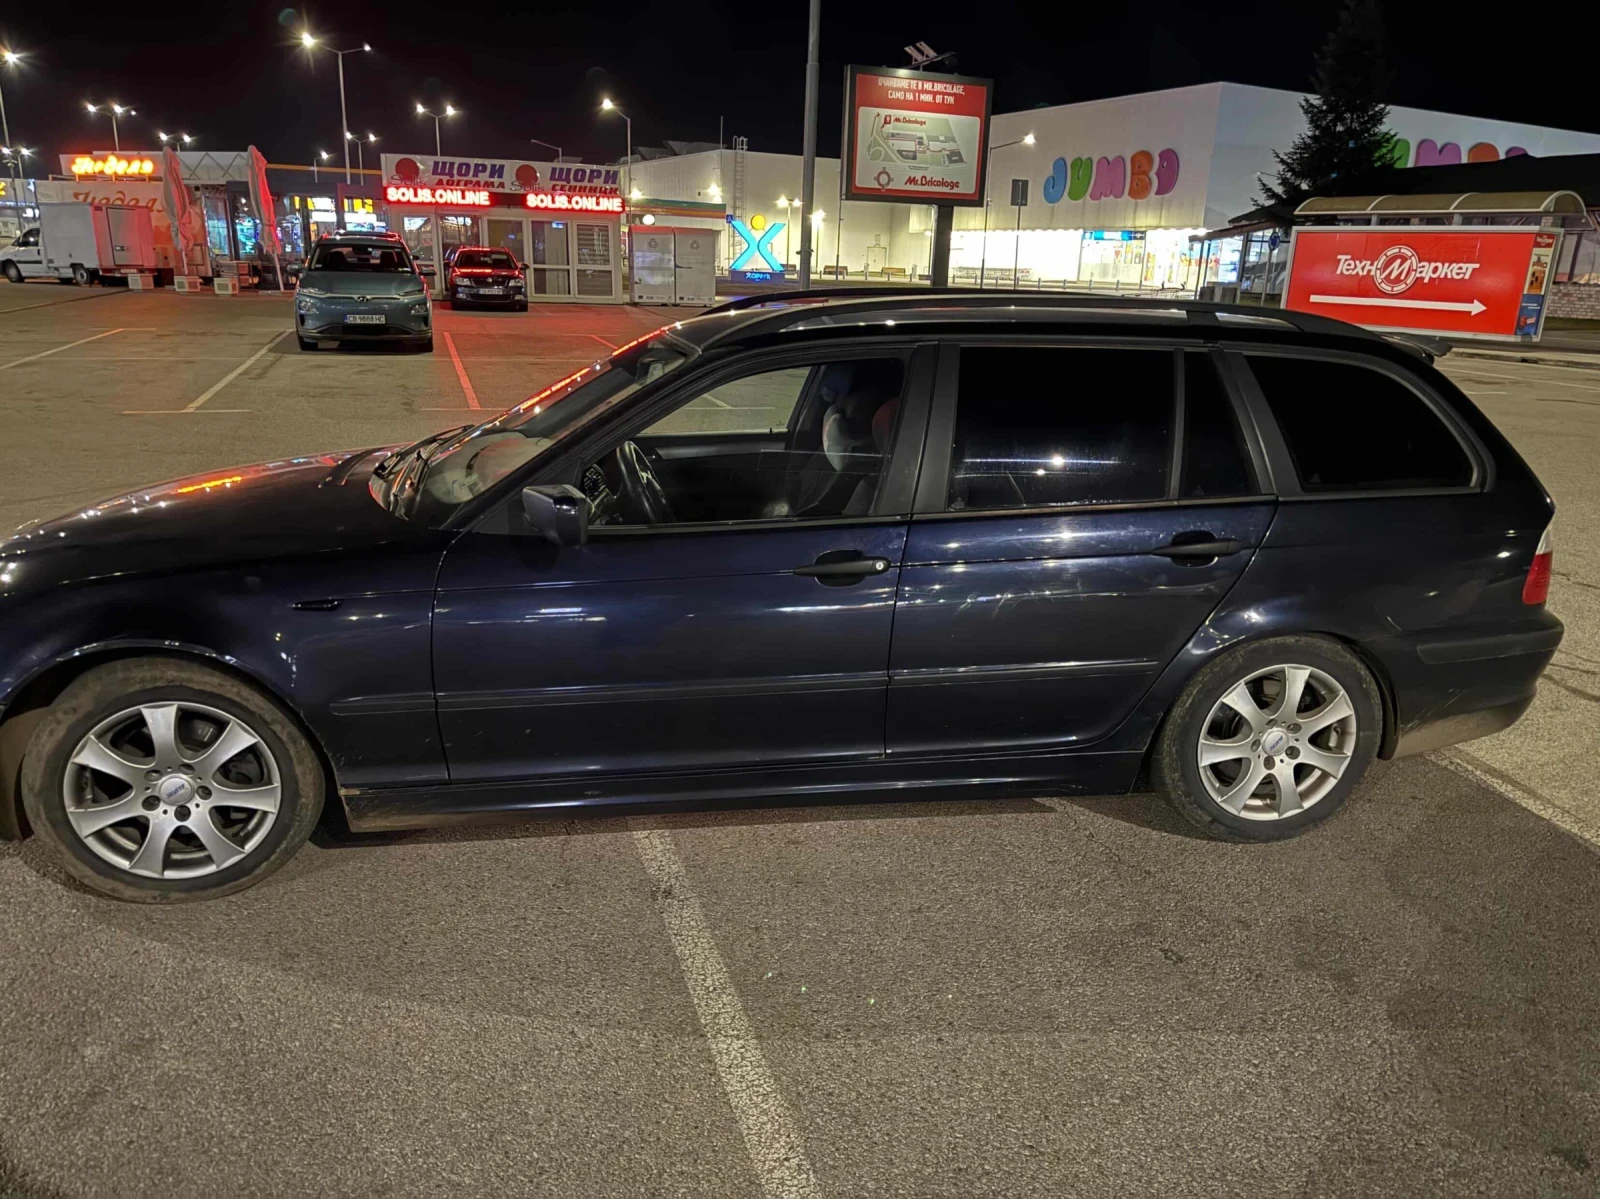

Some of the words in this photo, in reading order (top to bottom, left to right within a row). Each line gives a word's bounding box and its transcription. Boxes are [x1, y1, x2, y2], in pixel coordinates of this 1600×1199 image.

[888, 90, 905, 100] САМО
[905, 92, 914, 101] НА
[919, 93, 934, 103] МИН.
[935, 95, 943, 104] ОТ
[432, 160, 505, 179] ЩОРИ
[549, 166, 619, 185] ЩОРИ
[1043, 148, 1180, 204] JUMBO
[390, 173, 427, 187] Solis
[435, 178, 506, 189] ДОГРАМА
[510, 180, 545, 193] Solis
[904, 175, 960, 190] Mr.Bricolage
[386, 187, 491, 205] SOLIS.ONLINE
[526, 193, 623, 212] SOLIS.ONLINE
